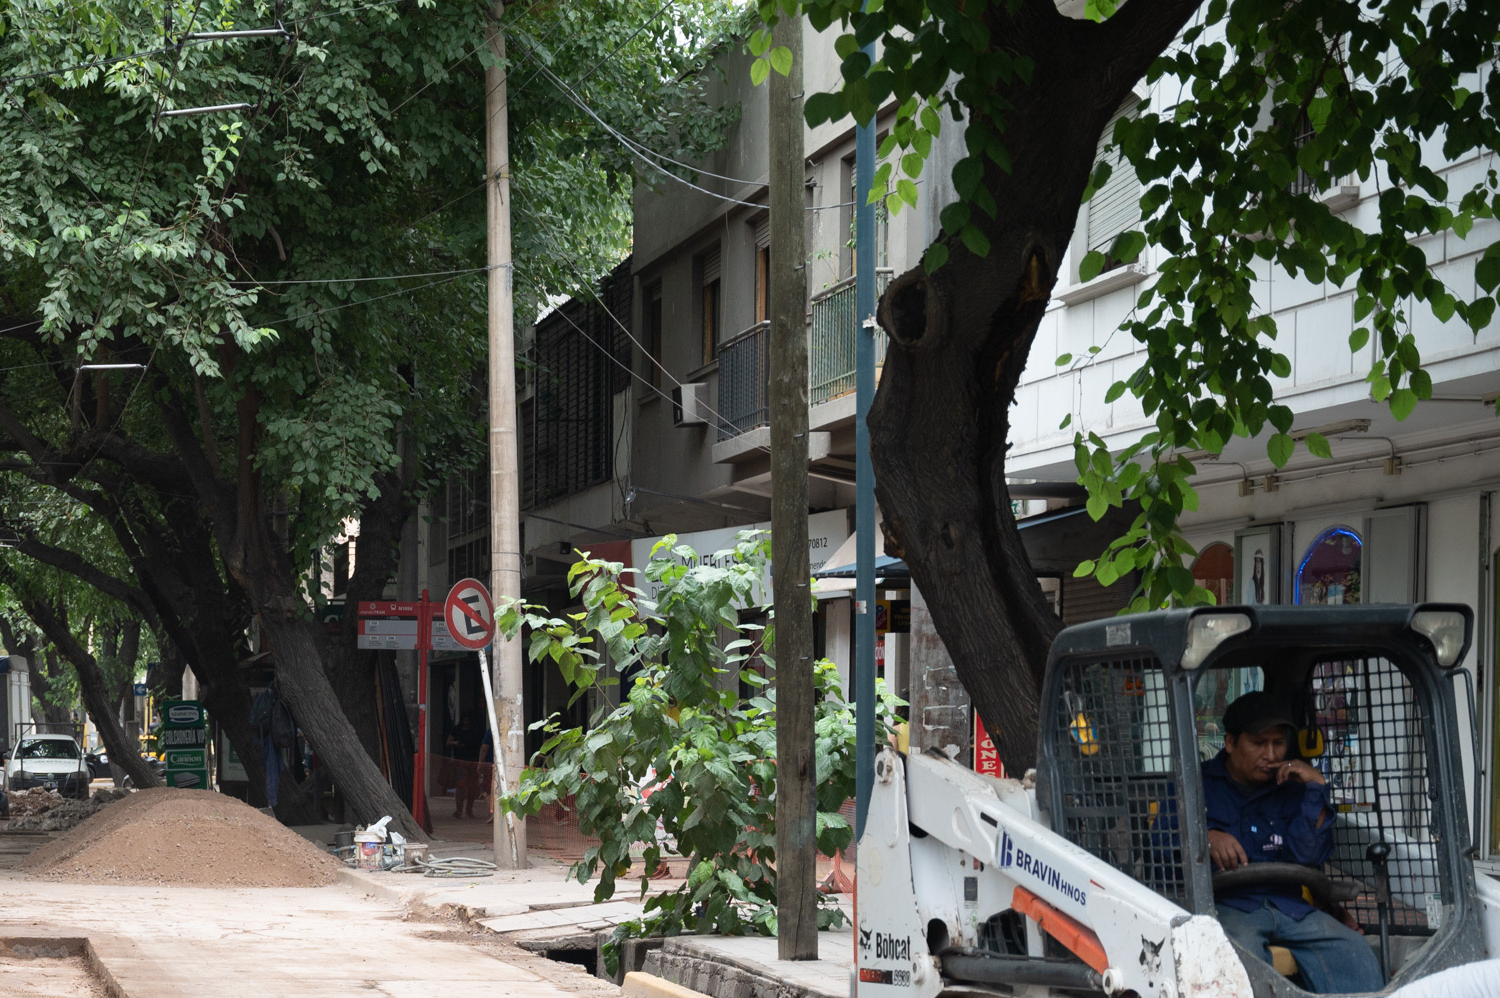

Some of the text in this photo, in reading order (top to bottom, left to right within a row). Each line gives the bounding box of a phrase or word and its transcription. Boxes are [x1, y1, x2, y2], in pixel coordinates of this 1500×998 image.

[170, 754, 203, 763] Cannon
[1015, 848, 1061, 891] BRAVIN
[1060, 879, 1087, 906] HNOS
[876, 931, 911, 961] Bobcat
